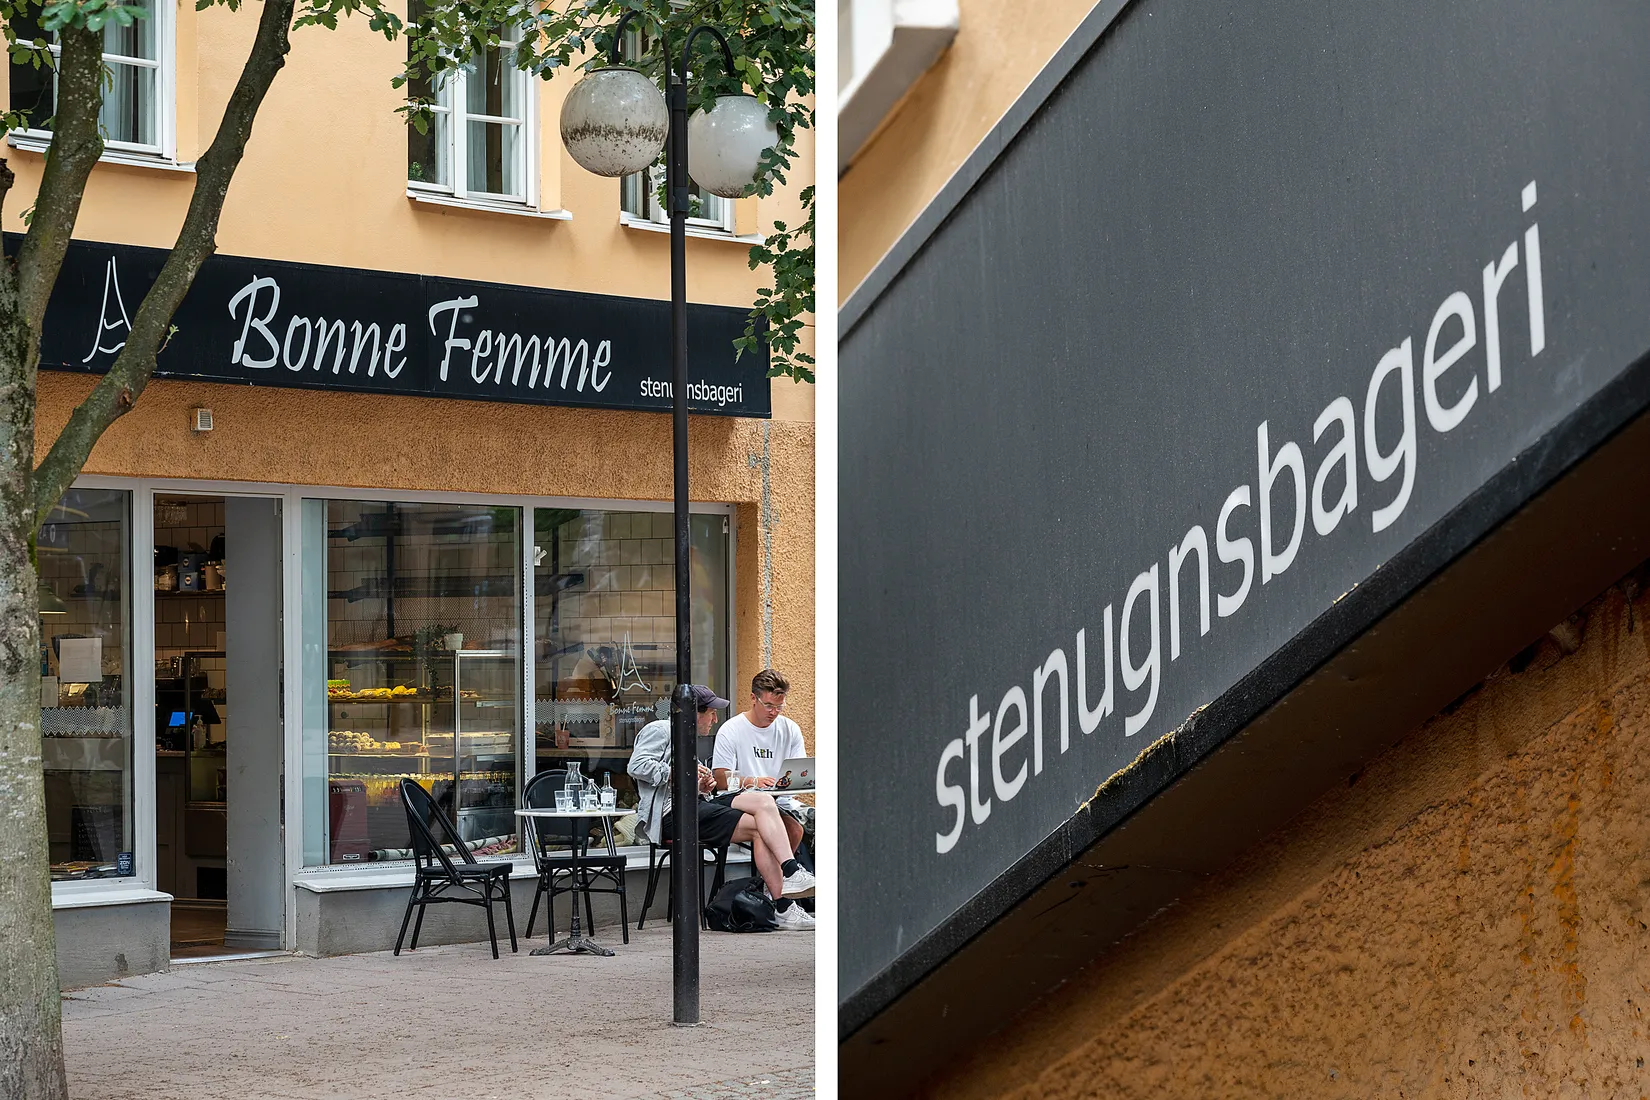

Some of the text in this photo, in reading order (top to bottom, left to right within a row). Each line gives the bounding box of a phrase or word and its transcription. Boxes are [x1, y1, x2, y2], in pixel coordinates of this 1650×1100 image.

[228, 274, 612, 393] Bonne Femme
[640, 376, 744, 407] stenunsbageri
[936, 180, 1545, 854] stenugnsbageri
